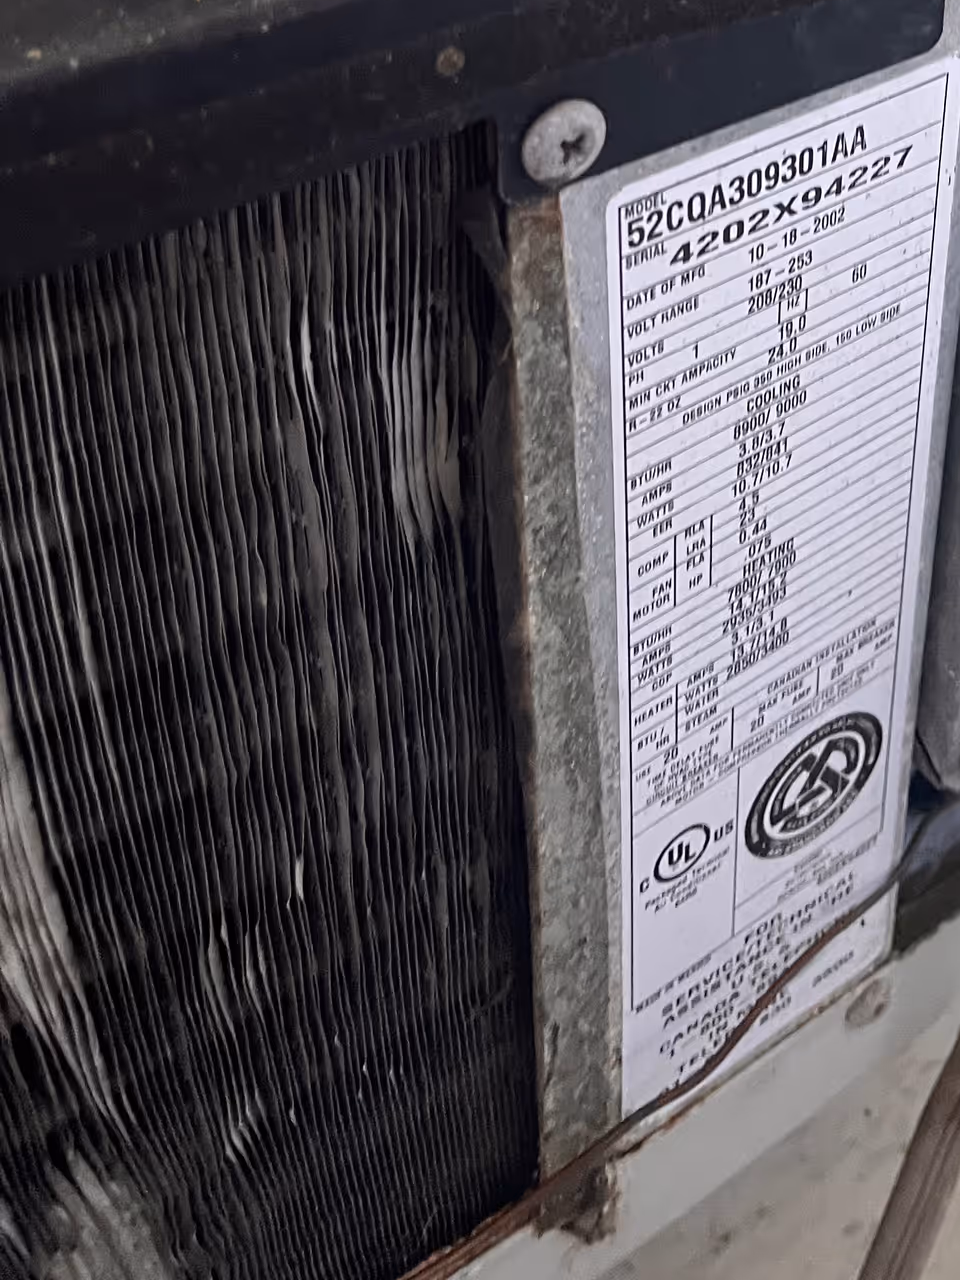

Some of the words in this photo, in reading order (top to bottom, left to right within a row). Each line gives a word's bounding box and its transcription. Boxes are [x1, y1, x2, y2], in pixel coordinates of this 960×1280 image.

[625, 191, 667, 219] MODEL
[625, 241, 667, 270] SERIAL
[669, 144, 913, 266] 4202X94227
[627, 124, 867, 249] 52CQA309301AA
[627, 286, 657, 312] DATE
[661, 277, 676, 295] OF
[627, 317, 657, 341] VOLT
[661, 294, 700, 325] RANGE
[628, 339, 665, 368] VOLTS
[747, 274, 803, 316] 208/230
[628, 370, 645, 388] PH
[692, 343, 699, 359] 1
[787, 295, 800, 311] HZ
[851, 263, 868, 284] 60
[629, 390, 651, 411] MIN
[655, 378, 678, 397] CKT
[681, 347, 737, 385] AMPACITY
[778, 314, 807, 341] 19.0
[667, 396, 682, 413] OZ
[767, 336, 798, 366] 24.0
[682, 396, 722, 426] DESIGN
[726, 382, 750, 403] PSIG
[776, 353, 801, 377] HIGH
[835, 331, 852, 346] 150
[855, 318, 878, 336] LOW
[880, 304, 901, 323] SIDE
[746, 374, 801, 412] COOLING
[630, 460, 672, 491] BTU/HR
[775, 389, 808, 418] 9000
[641, 481, 673, 508] AMPS
[738, 421, 786, 459] 3.8/3.7
[636, 499, 675, 529] WATTS
[652, 517, 673, 538] EER
[731, 453, 793, 498] 10.7/10.7
[739, 507, 755, 528] 23
[637, 551, 669, 578] COMP
[738, 489, 760, 512] 4.5
[652, 578, 672, 599] FAN
[686, 552, 705, 571] FLA
[738, 516, 768, 545] 0.44
[742, 537, 795, 579] HEATING
[633, 593, 671, 620] MOTOR
[688, 573, 703, 590] HP
[633, 624, 672, 656] BTU/HR
[642, 642, 671, 667] AMPS
[651, 673, 673, 692] COP
[731, 607, 774, 645] 3.1/3.1
[637, 654, 673, 684] WATTS
[684, 676, 719, 703] WATTS
[767, 659, 813, 694] CANADIAN
[634, 695, 673, 727] HEATER
[684, 688, 719, 716] WATER
[750, 716, 765, 733] 20
[792, 686, 812, 705] AMP
[656, 735, 670, 751] HR
[685, 705, 717, 732] STEAM
[664, 747, 679, 765] 20
[709, 717, 728, 735] AMP
[639, 877, 650, 893] C
[668, 840, 697, 867] UL
[713, 818, 734, 843] US
[744, 912, 783, 944] FOR
[659, 991, 740, 1055] CANADA
